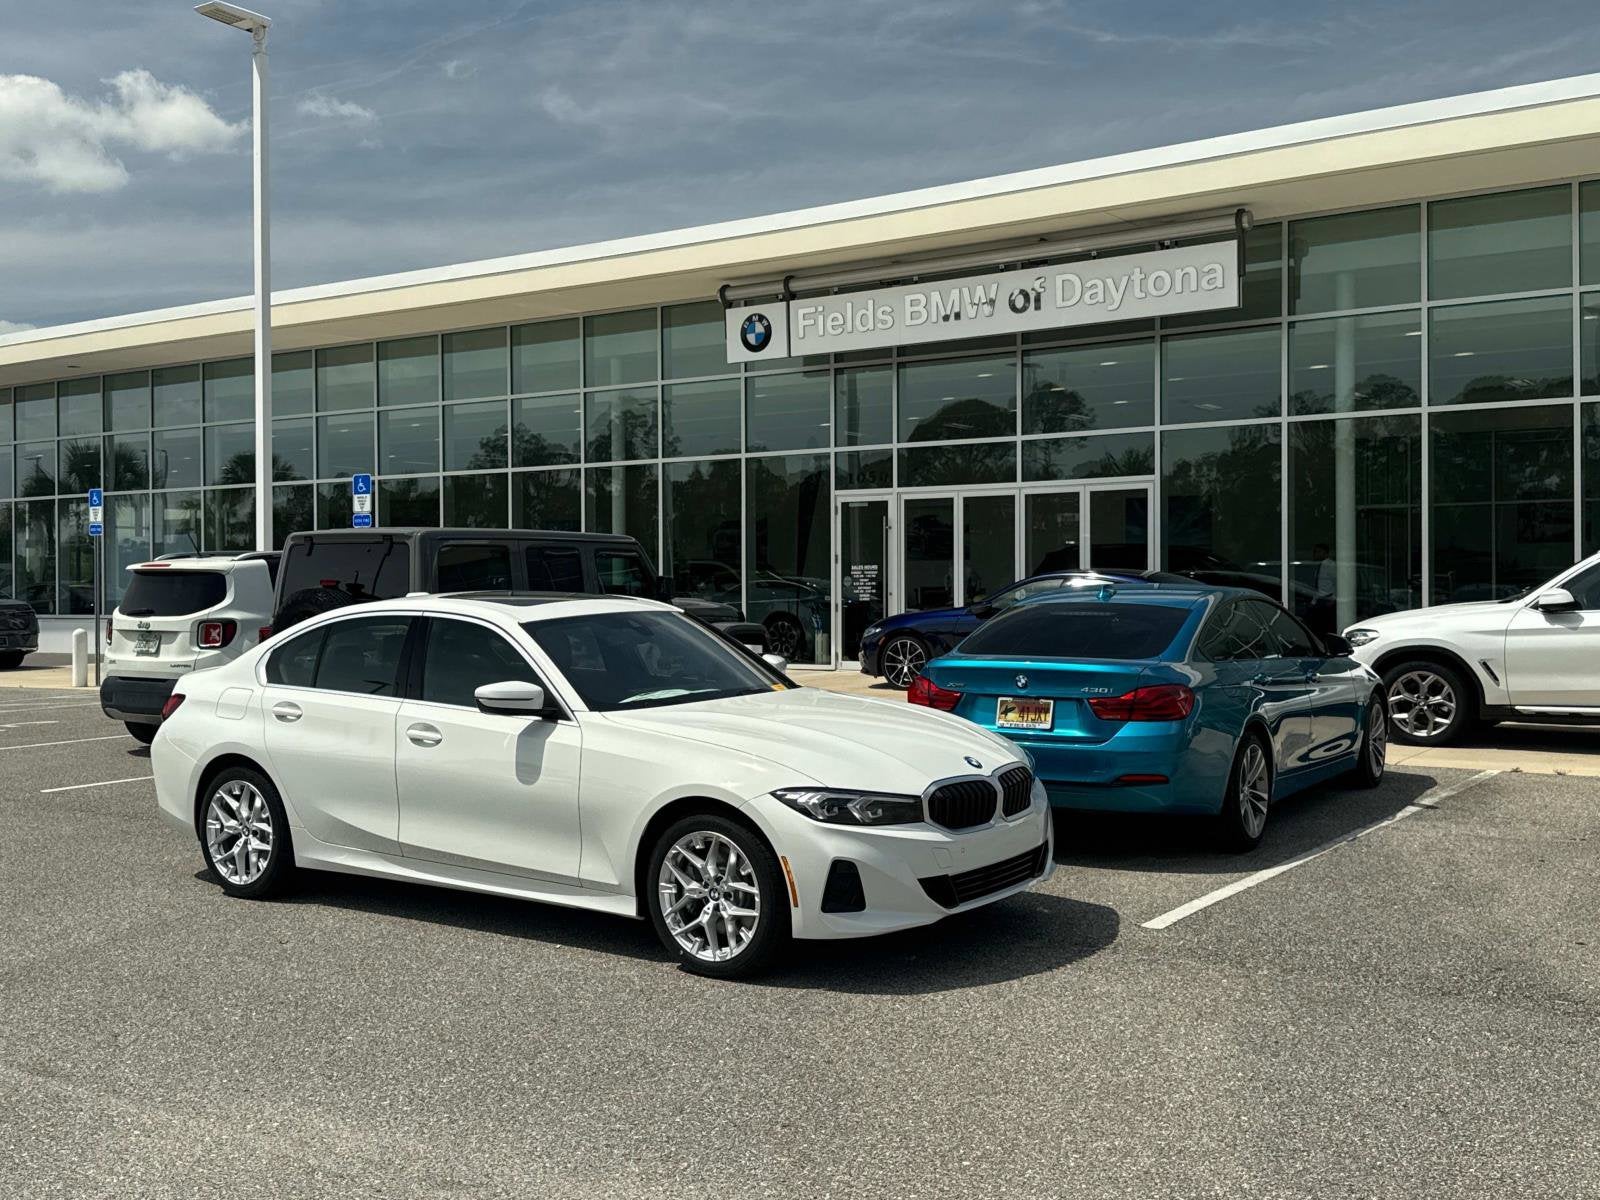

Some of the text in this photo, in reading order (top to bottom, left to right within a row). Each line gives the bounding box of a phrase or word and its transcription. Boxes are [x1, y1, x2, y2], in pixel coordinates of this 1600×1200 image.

[797, 261, 1225, 340] Fields BMW of Daytona
